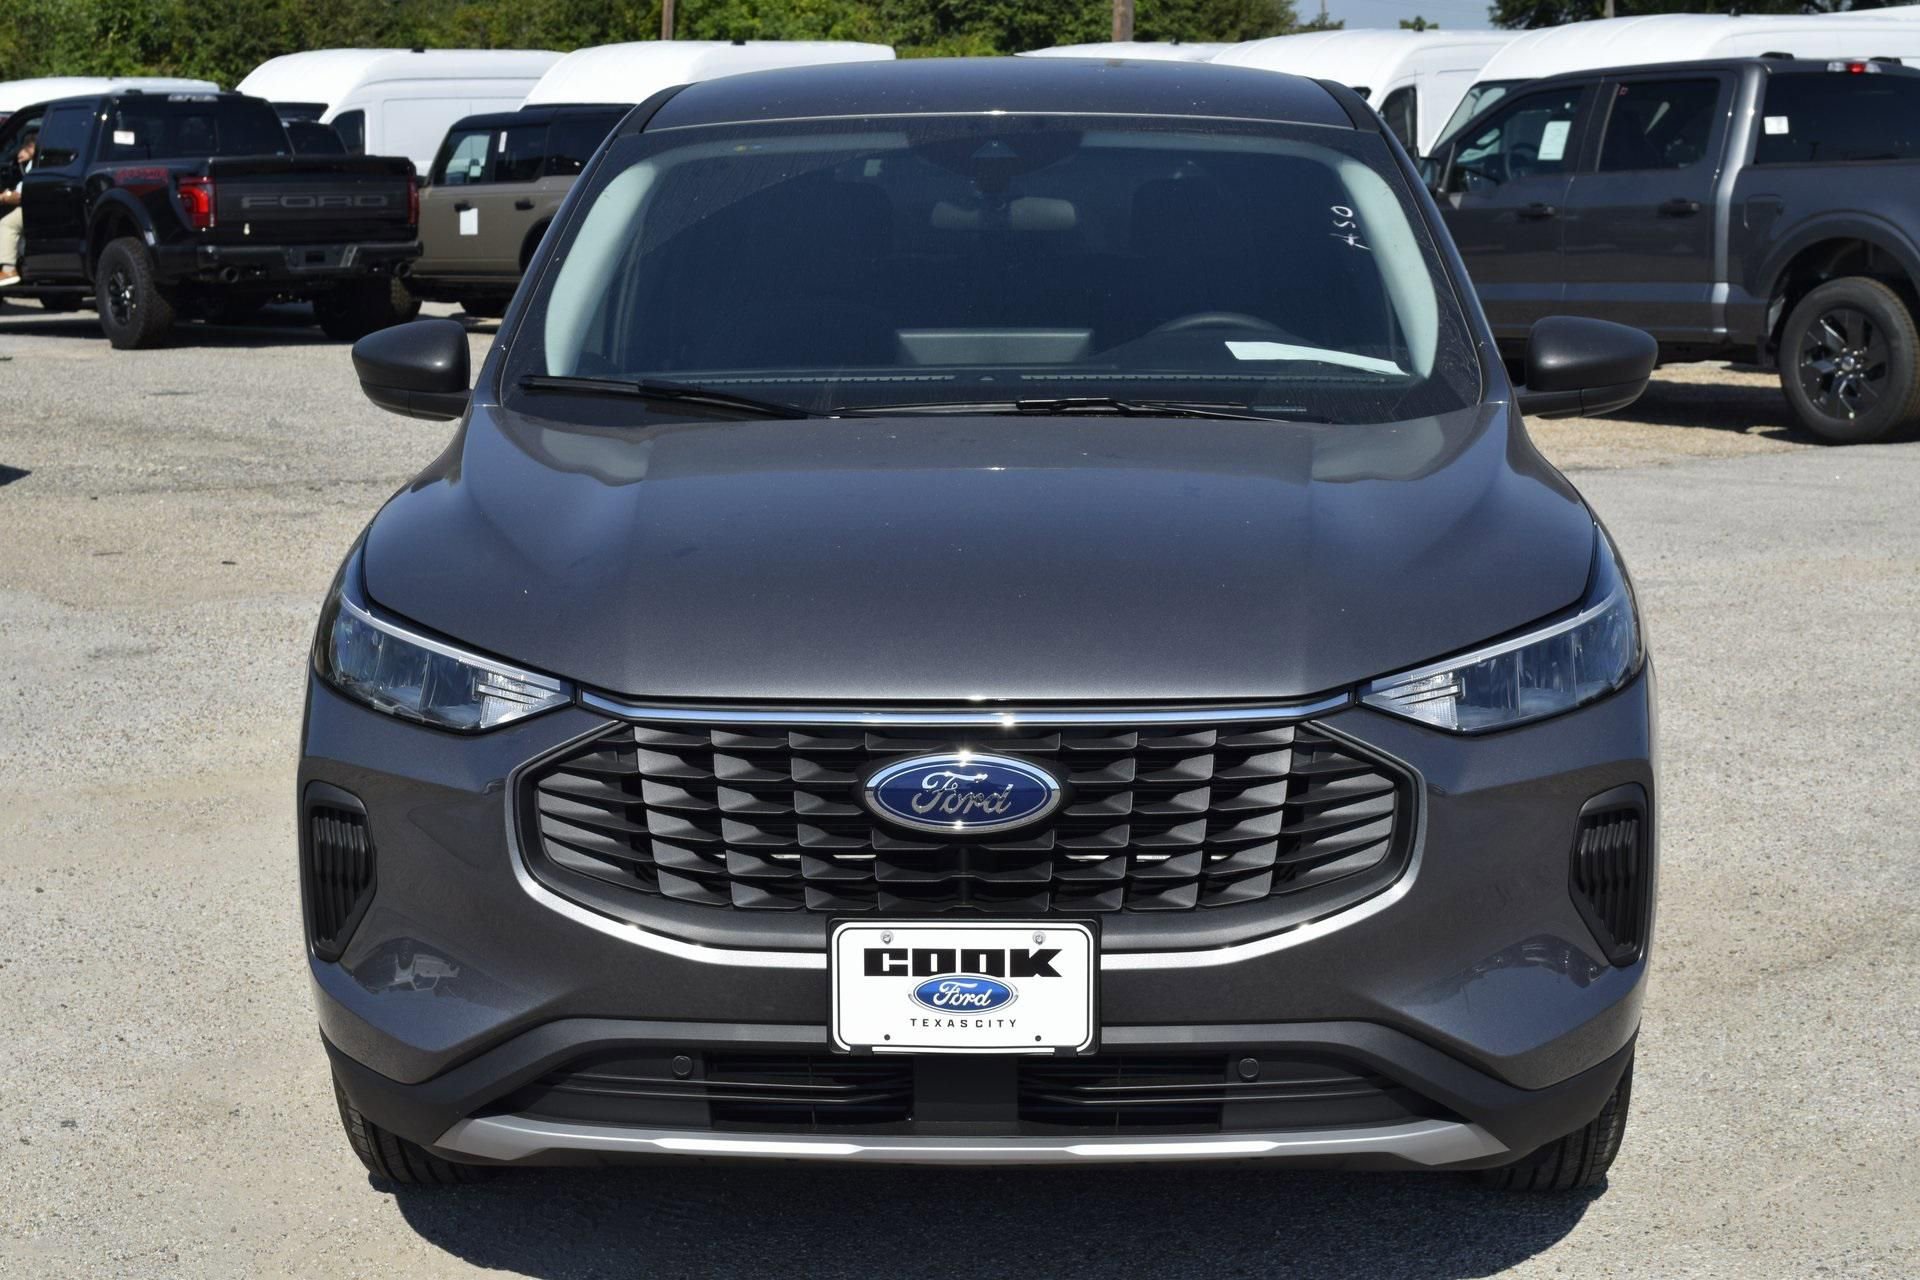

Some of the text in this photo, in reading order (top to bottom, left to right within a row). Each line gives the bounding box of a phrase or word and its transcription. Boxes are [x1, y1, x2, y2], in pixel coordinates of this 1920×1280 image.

[241, 195, 388, 209] FORD
[911, 771, 1014, 815] Ford
[863, 948, 1063, 978] COOK
[932, 981, 992, 1007] Ford
[910, 1018, 1018, 1028] TEXAS CITY
